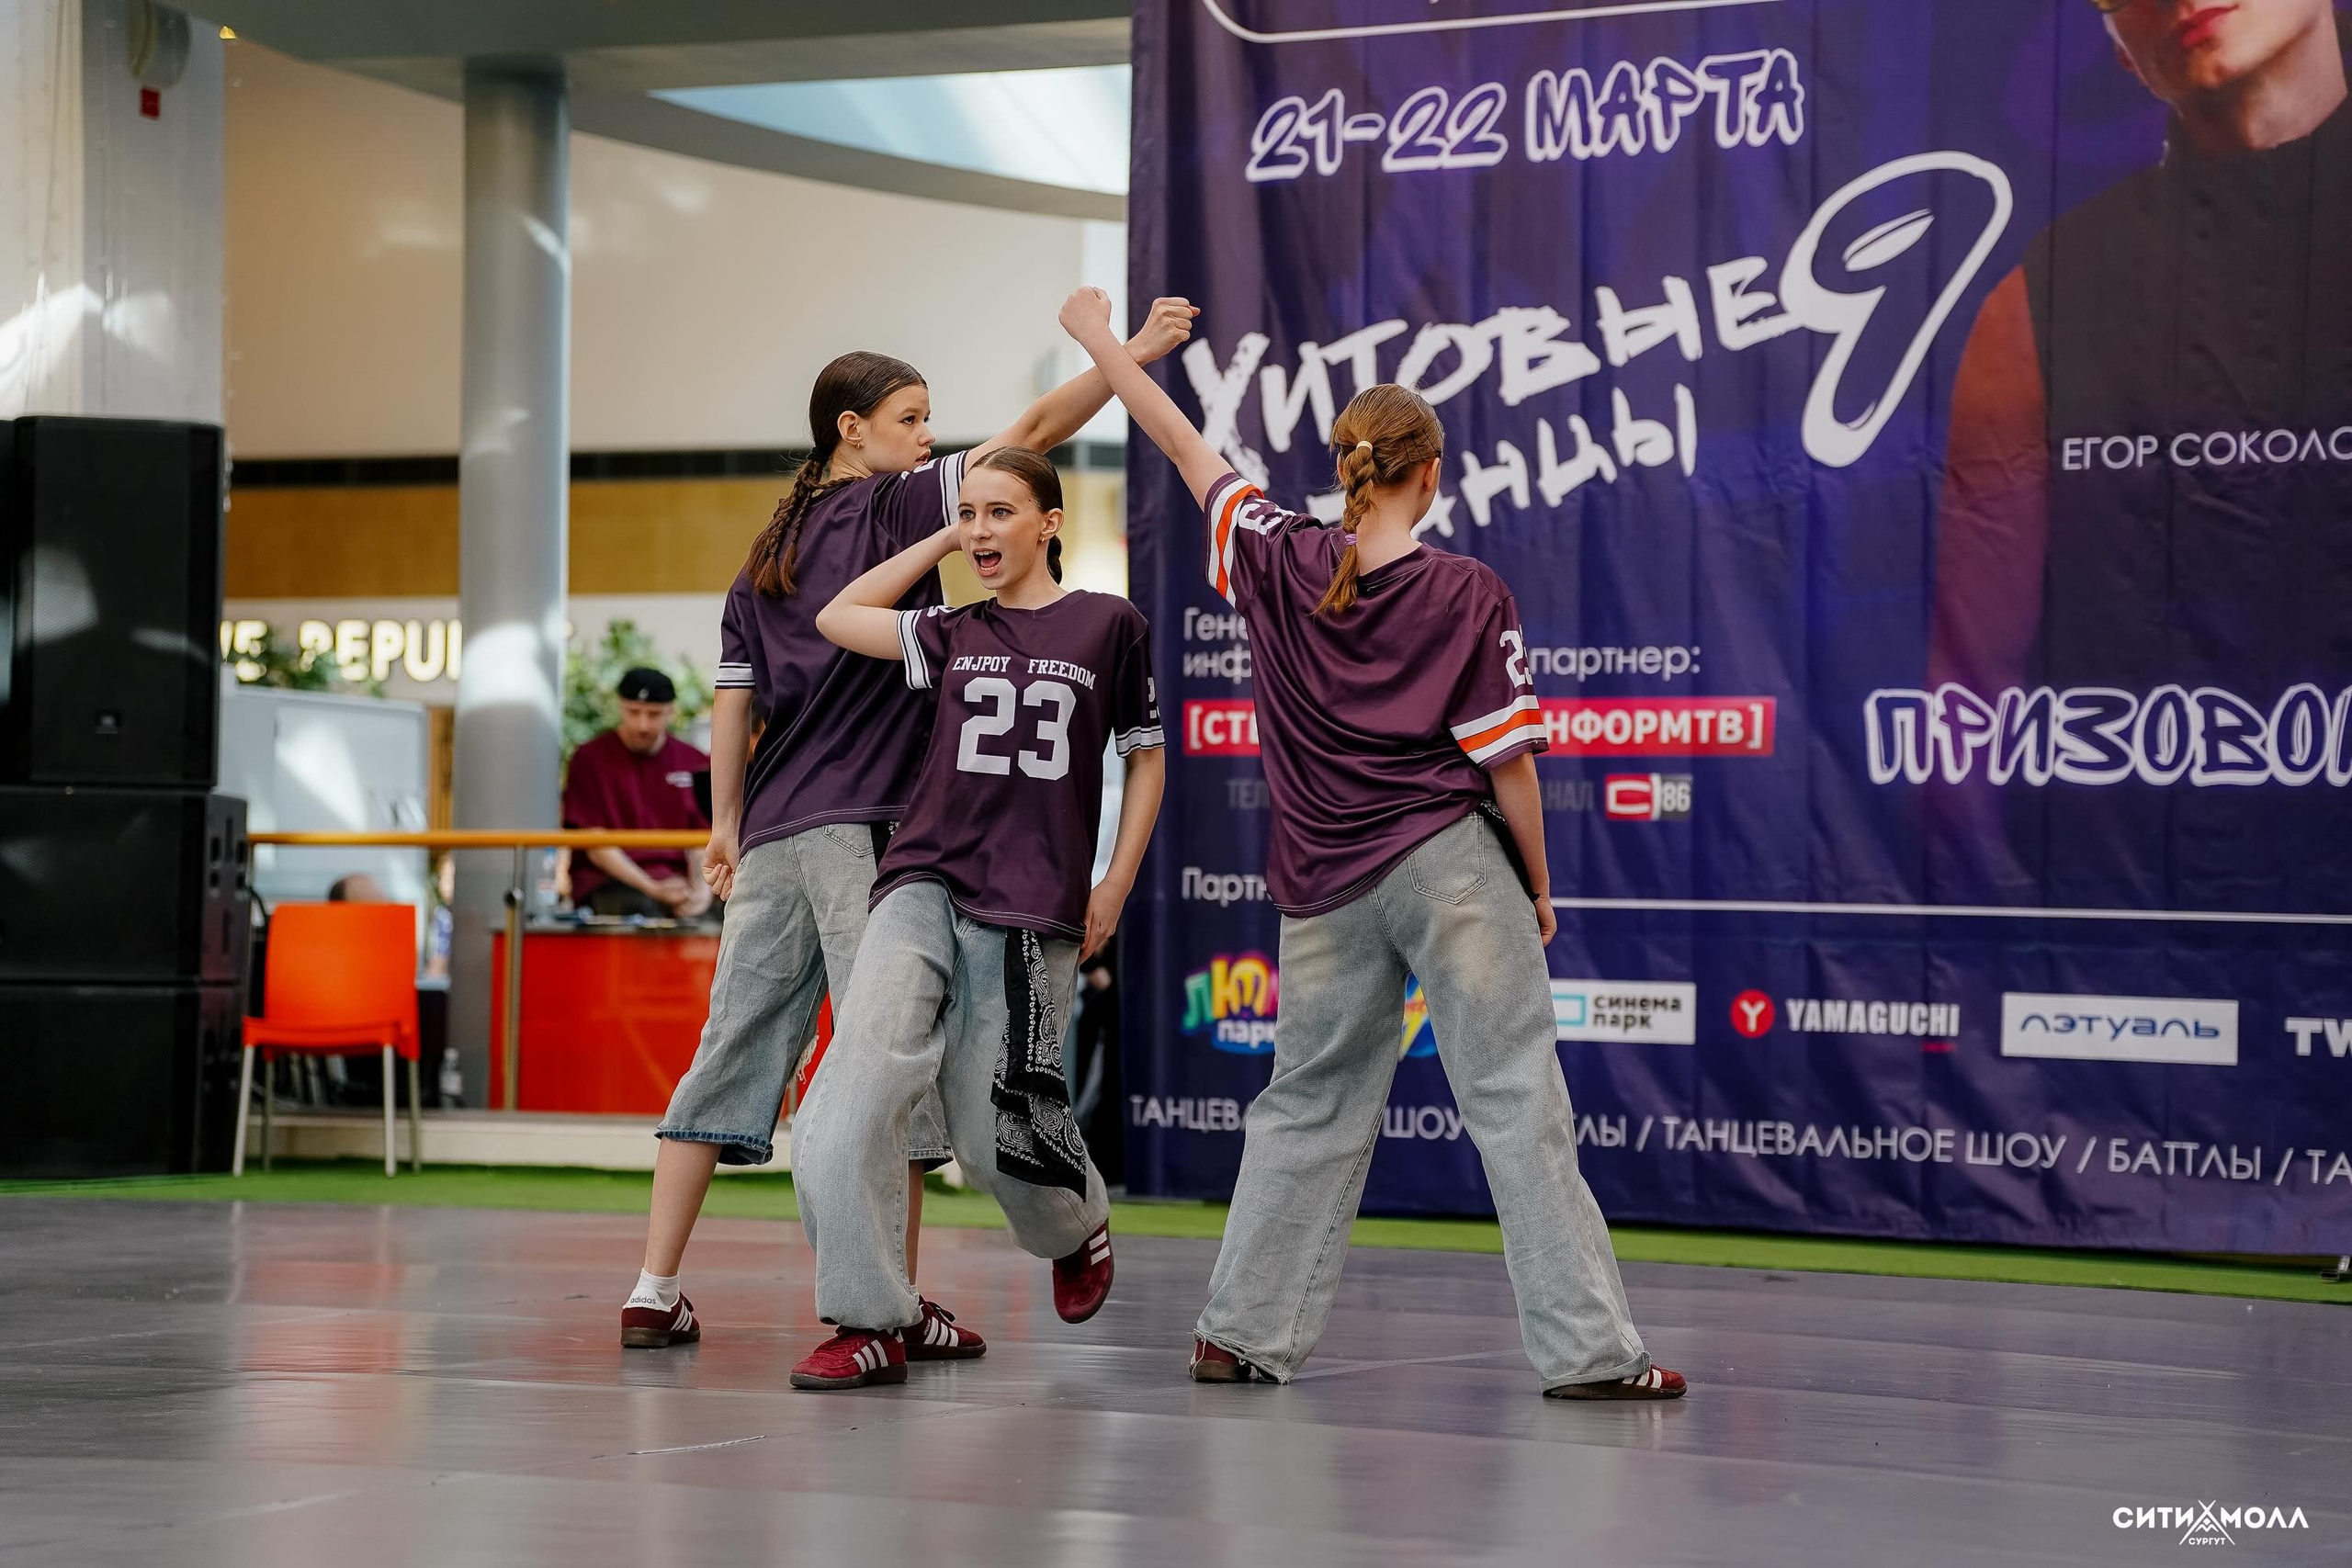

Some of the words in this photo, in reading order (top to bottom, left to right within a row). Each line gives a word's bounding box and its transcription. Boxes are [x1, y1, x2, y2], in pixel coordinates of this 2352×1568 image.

[1245, 82, 1509, 183] 21-22
[1523, 48, 1806, 164] МАРТА
[1306, 383, 1699, 540] НЦЫ
[2062, 434, 2159, 471] ЕГОР
[2169, 425, 2352, 468] СОКОЛО
[952, 655, 1012, 672] ENJPOY
[1027, 658, 1097, 691] FREEDOM
[1499, 624, 1533, 689] 2
[1529, 645, 1702, 682] партнер:
[956, 676, 1077, 781] 23
[1592, 994, 1682, 1012] синема
[1592, 1013, 1653, 1034] парк
[1784, 998, 1961, 1037] YAMAGUCHI
[1129, 1093, 1250, 1134] ТАНЦЕВ
[1382, 1105, 1464, 1141] ШОУ
[1574, 1111, 1627, 1148] ЛЫ
[1661, 1114, 1956, 1163] ТАНЦЕВАЛЬНОЕ
[1964, 1130, 2067, 1170] ШОУ
[2108, 1138, 2261, 1181] БАТТЛЫ
[630, 1295, 657, 1305] adidas
